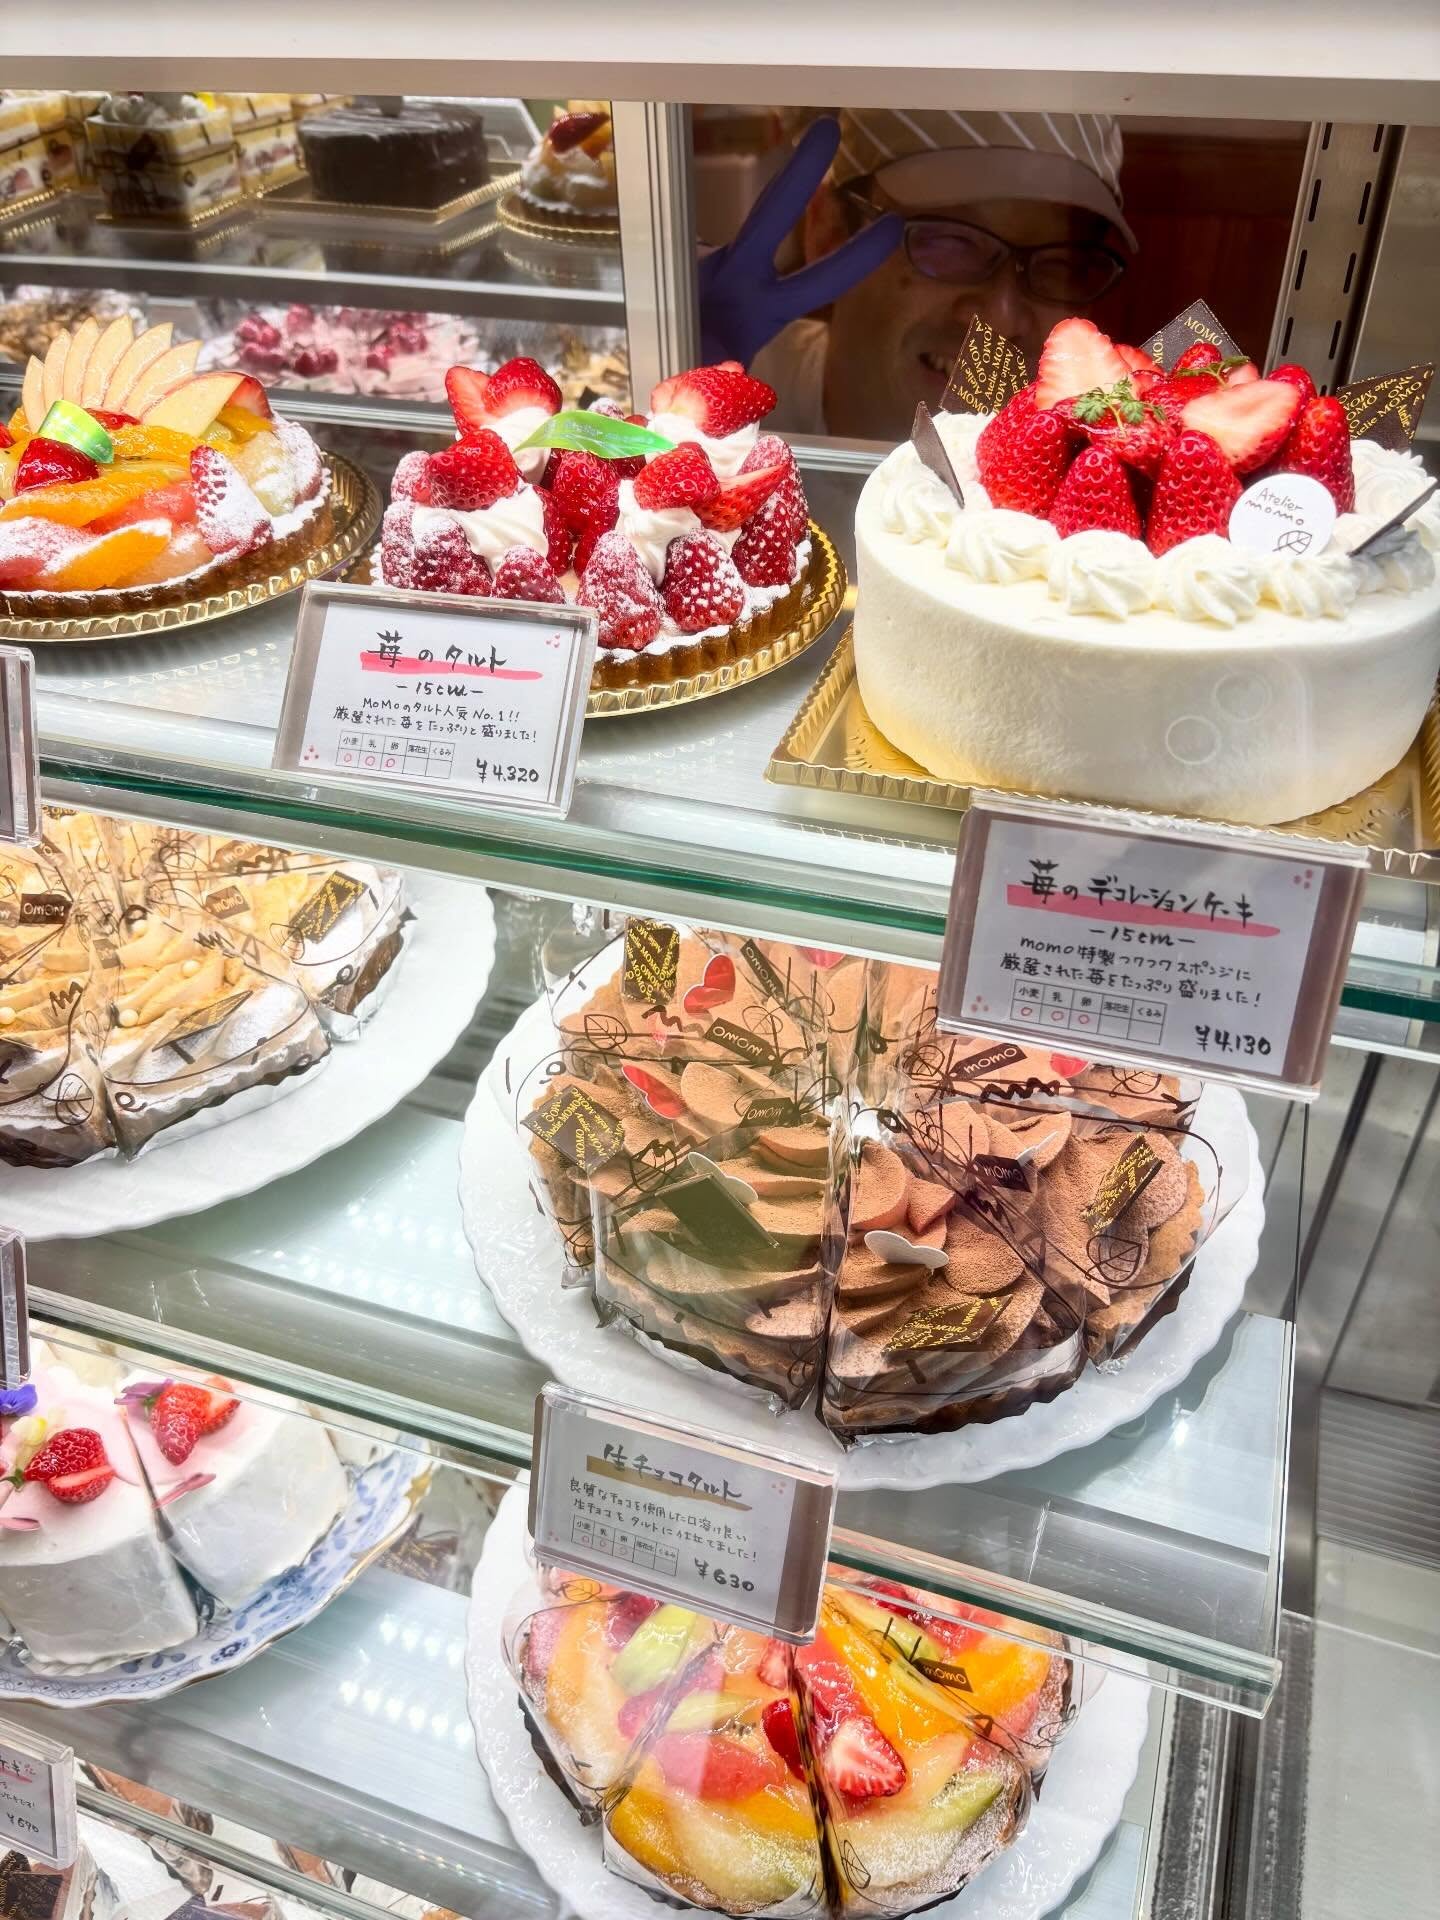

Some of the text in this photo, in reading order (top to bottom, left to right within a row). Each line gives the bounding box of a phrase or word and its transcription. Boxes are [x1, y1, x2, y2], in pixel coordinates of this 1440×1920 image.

[1184, 317, 1223, 346] MOMO
[968, 339, 988, 384] MOMO
[956, 385, 989, 416] MOMO
[1377, 381, 1422, 417] MOMO
[1245, 499, 1305, 526] momo
[1257, 487, 1304, 511] Atelier
[367, 629, 508, 673] 苺のタルト
[1020, 858, 1255, 928] 苺のデコレーションケーキ
[1018, 986, 1041, 1000] 小麦
[1052, 990, 1064, 1004] 乳
[1136, 1006, 1162, 1020] くるみ
[602, 1442, 743, 1503] 生チョコタルト
[694, 1557, 755, 1592] ¥630
